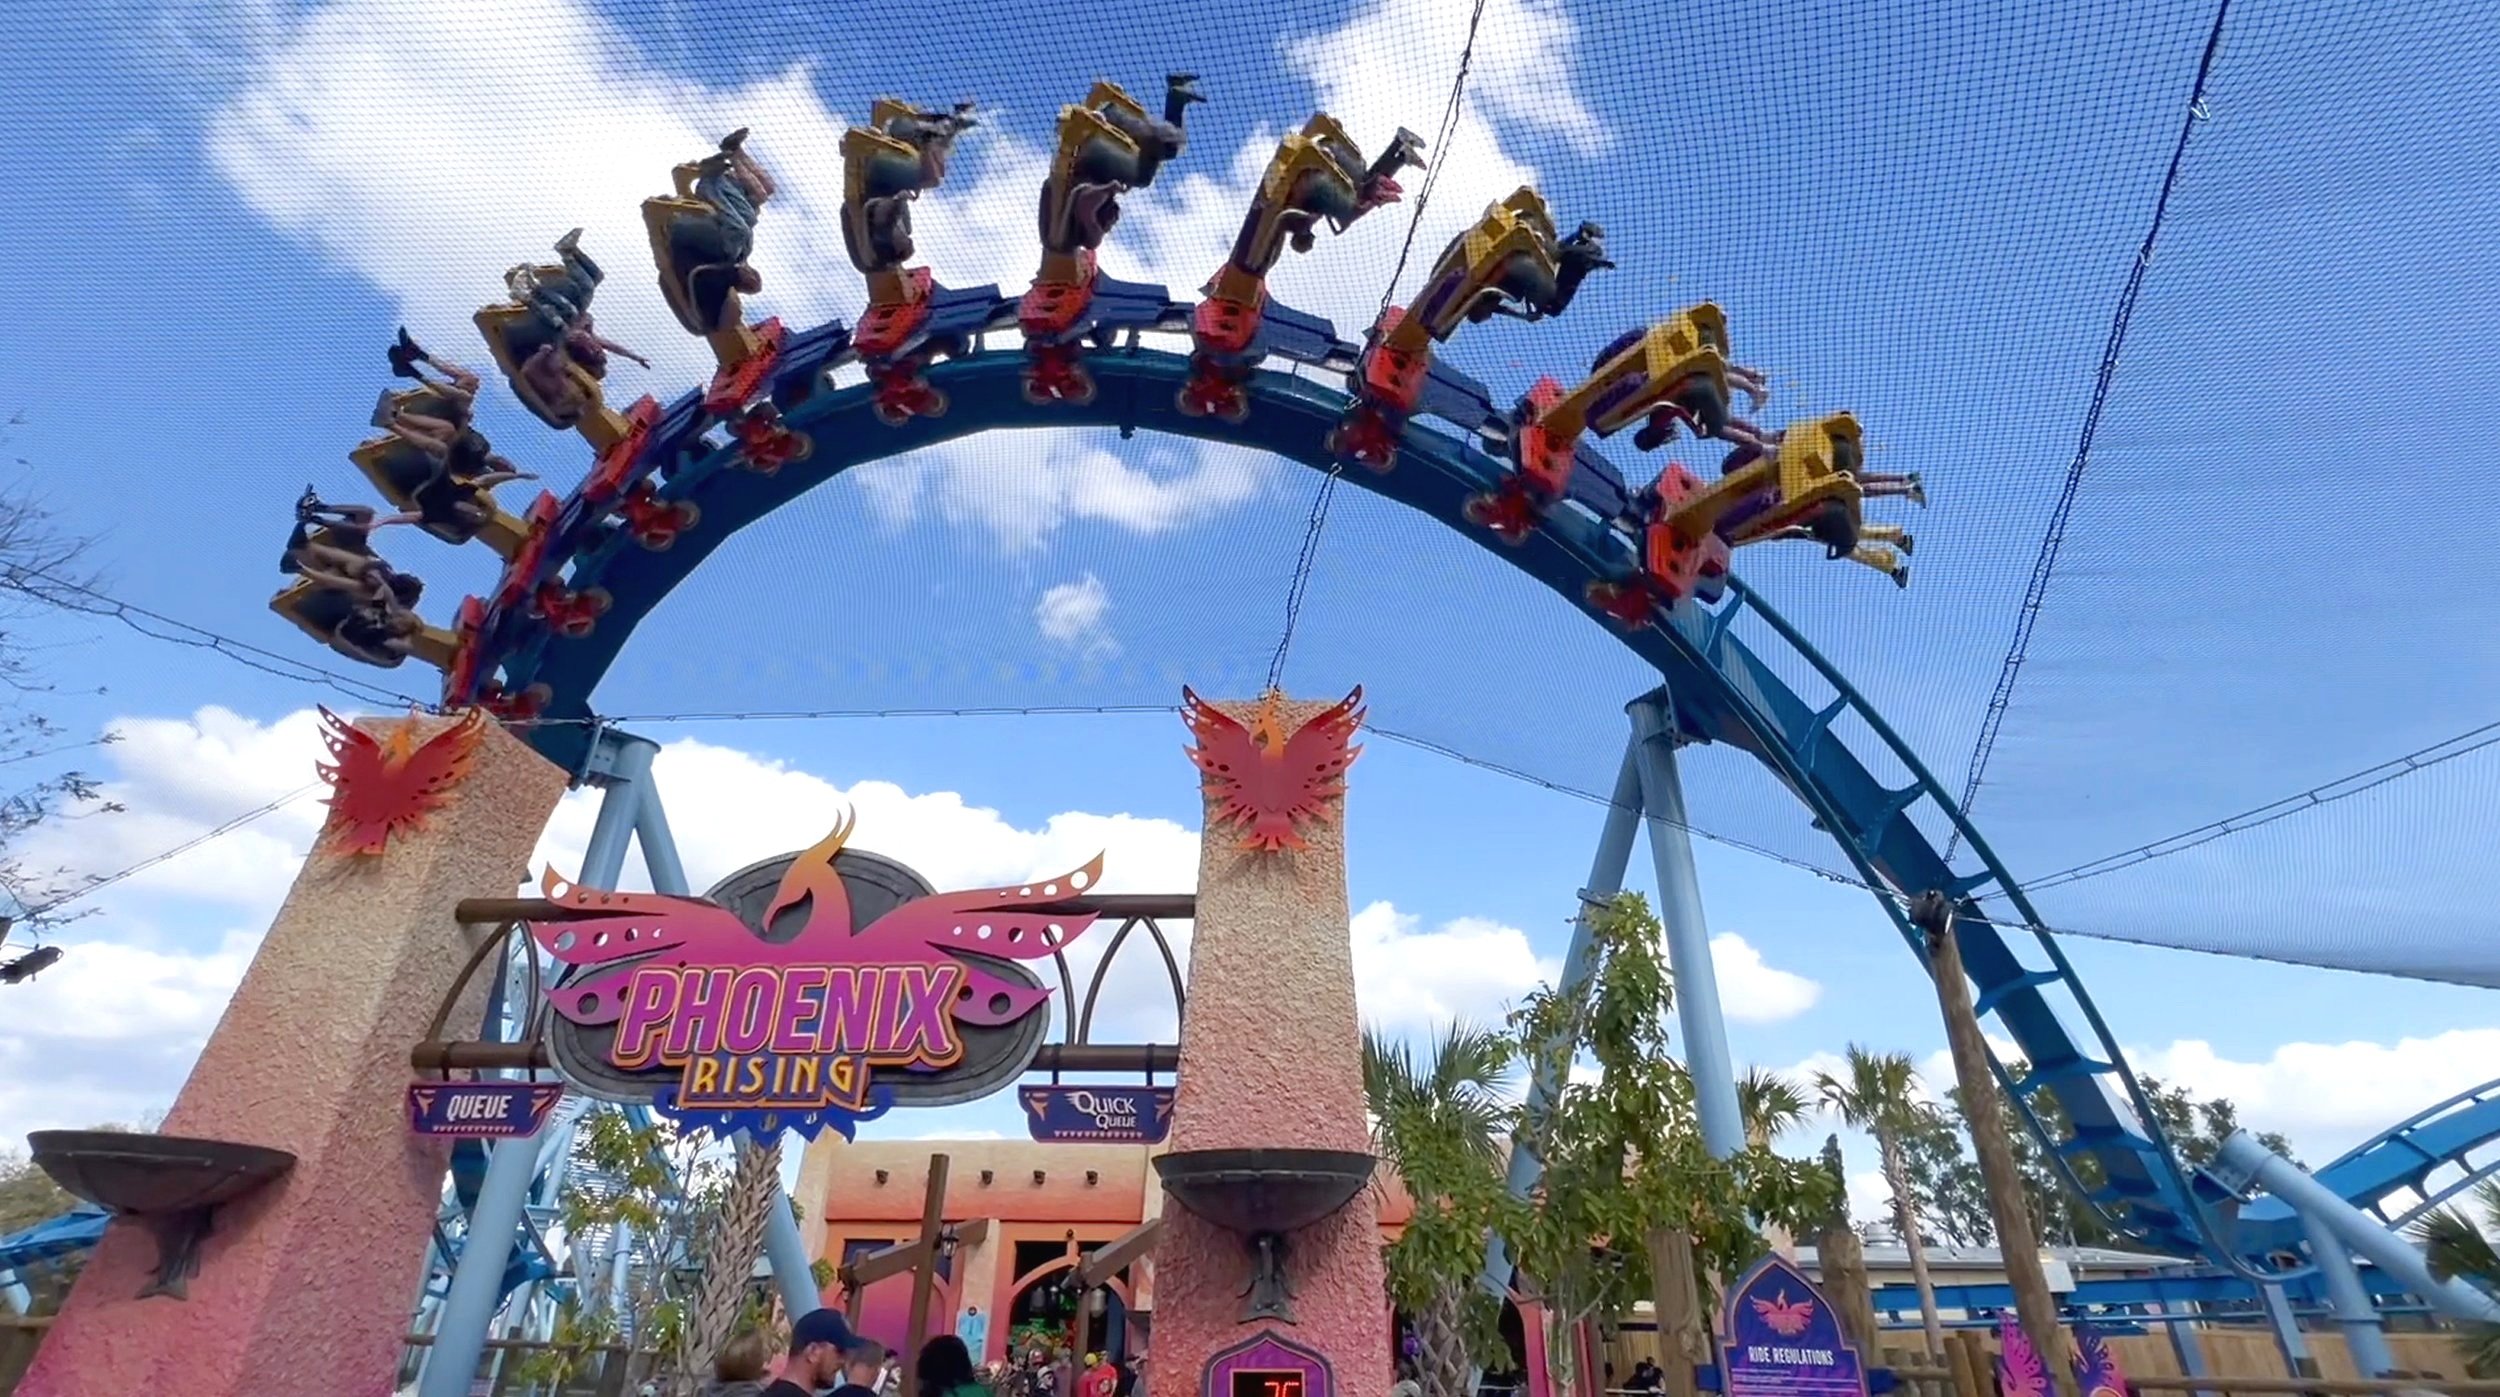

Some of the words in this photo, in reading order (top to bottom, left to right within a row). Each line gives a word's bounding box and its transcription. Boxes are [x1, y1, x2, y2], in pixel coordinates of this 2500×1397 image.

[615, 965, 959, 1054] PHOENIX
[690, 1056, 854, 1095] RISING
[446, 1094, 513, 1121] QUEUE
[1066, 1090, 1137, 1116] QUICK
[1095, 1114, 1137, 1130] QUEUE
[1747, 1346, 1773, 1363] RIDE
[1773, 1348, 1835, 1366] REGULATIONS
